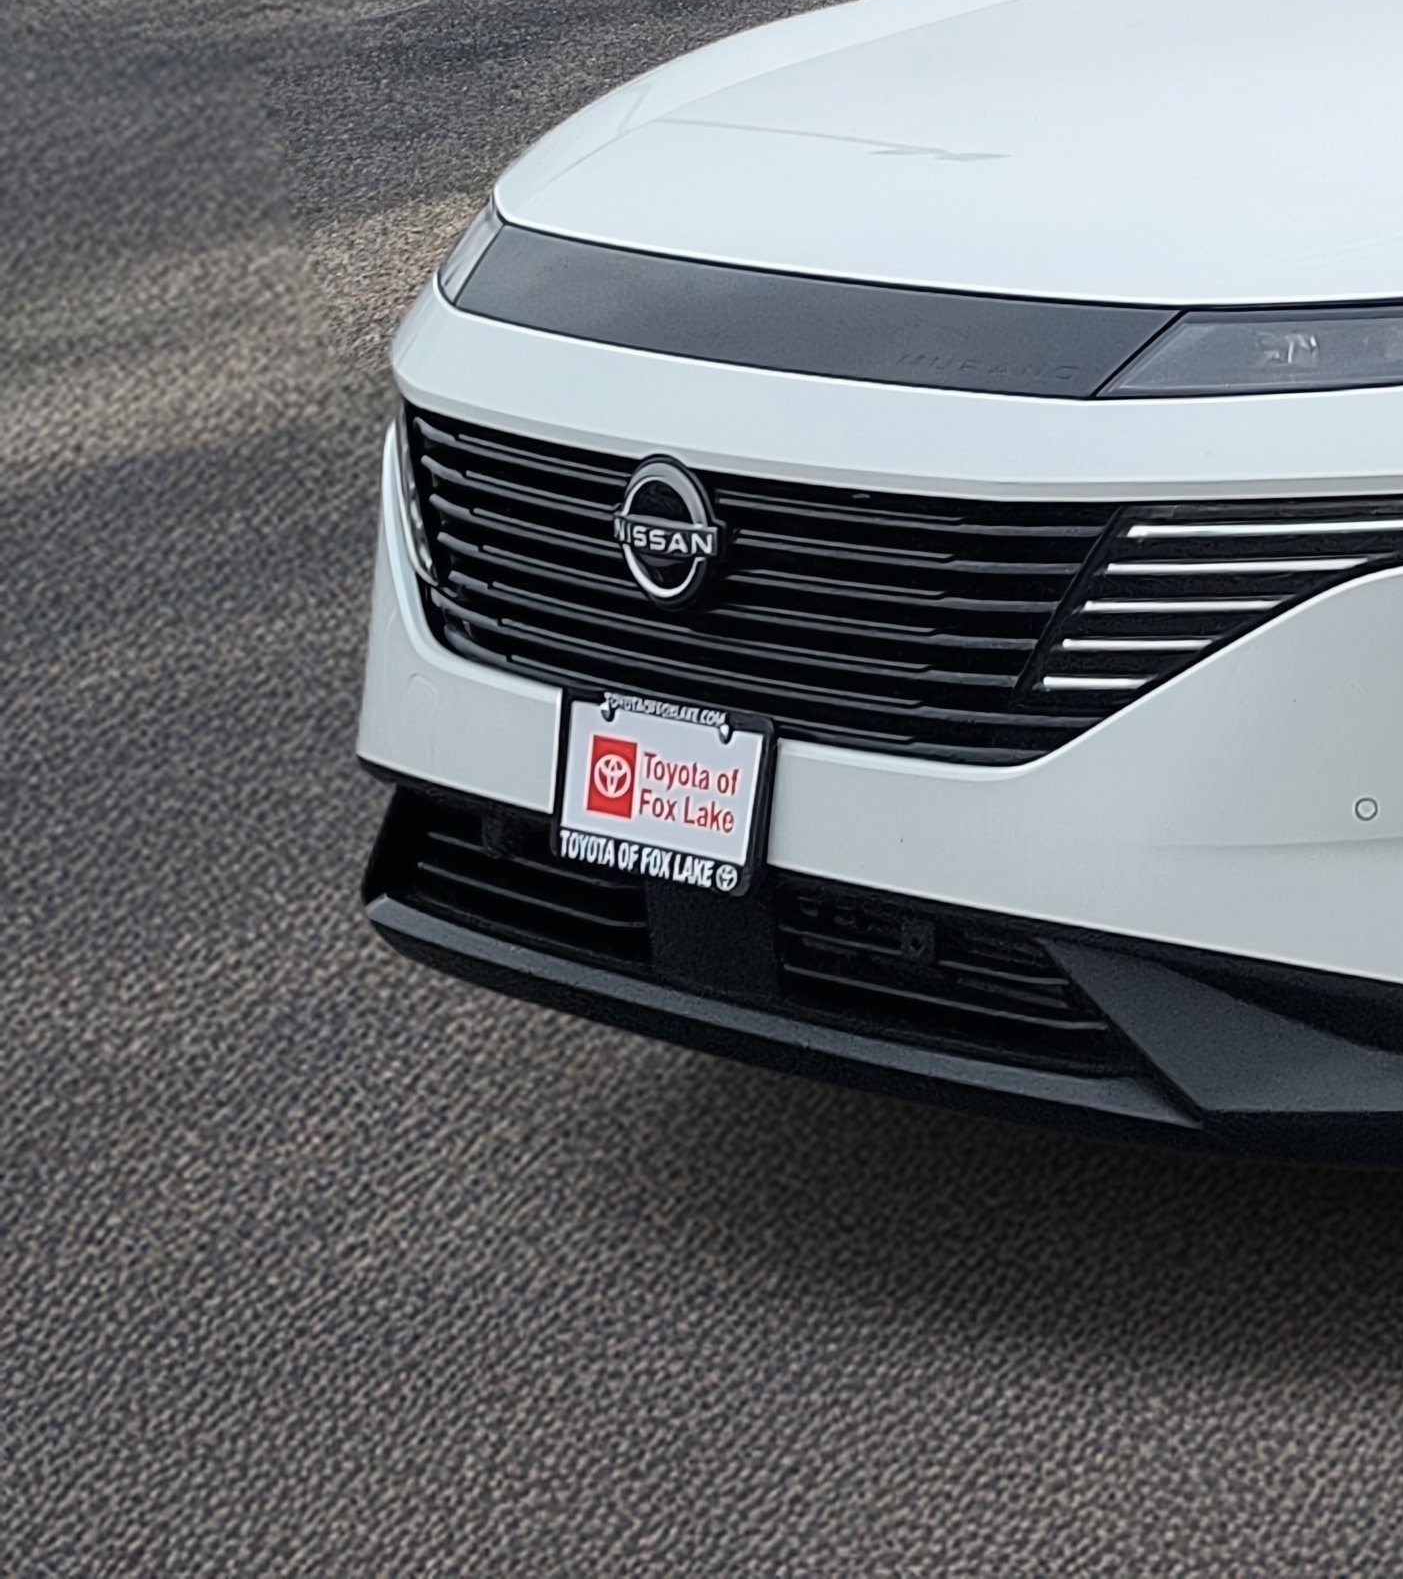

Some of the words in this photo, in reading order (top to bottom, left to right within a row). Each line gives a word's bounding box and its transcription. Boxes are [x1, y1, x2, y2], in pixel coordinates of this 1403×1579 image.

[614, 519, 713, 554] NISSAN
[644, 751, 710, 791] Toyota
[717, 768, 740, 797] of
[638, 789, 678, 822] Fox
[684, 795, 735, 833] Lake
[560, 830, 616, 867] TOYOTA
[617, 842, 640, 872] OF
[640, 847, 674, 880] FOX
[672, 854, 716, 889] LAKE
